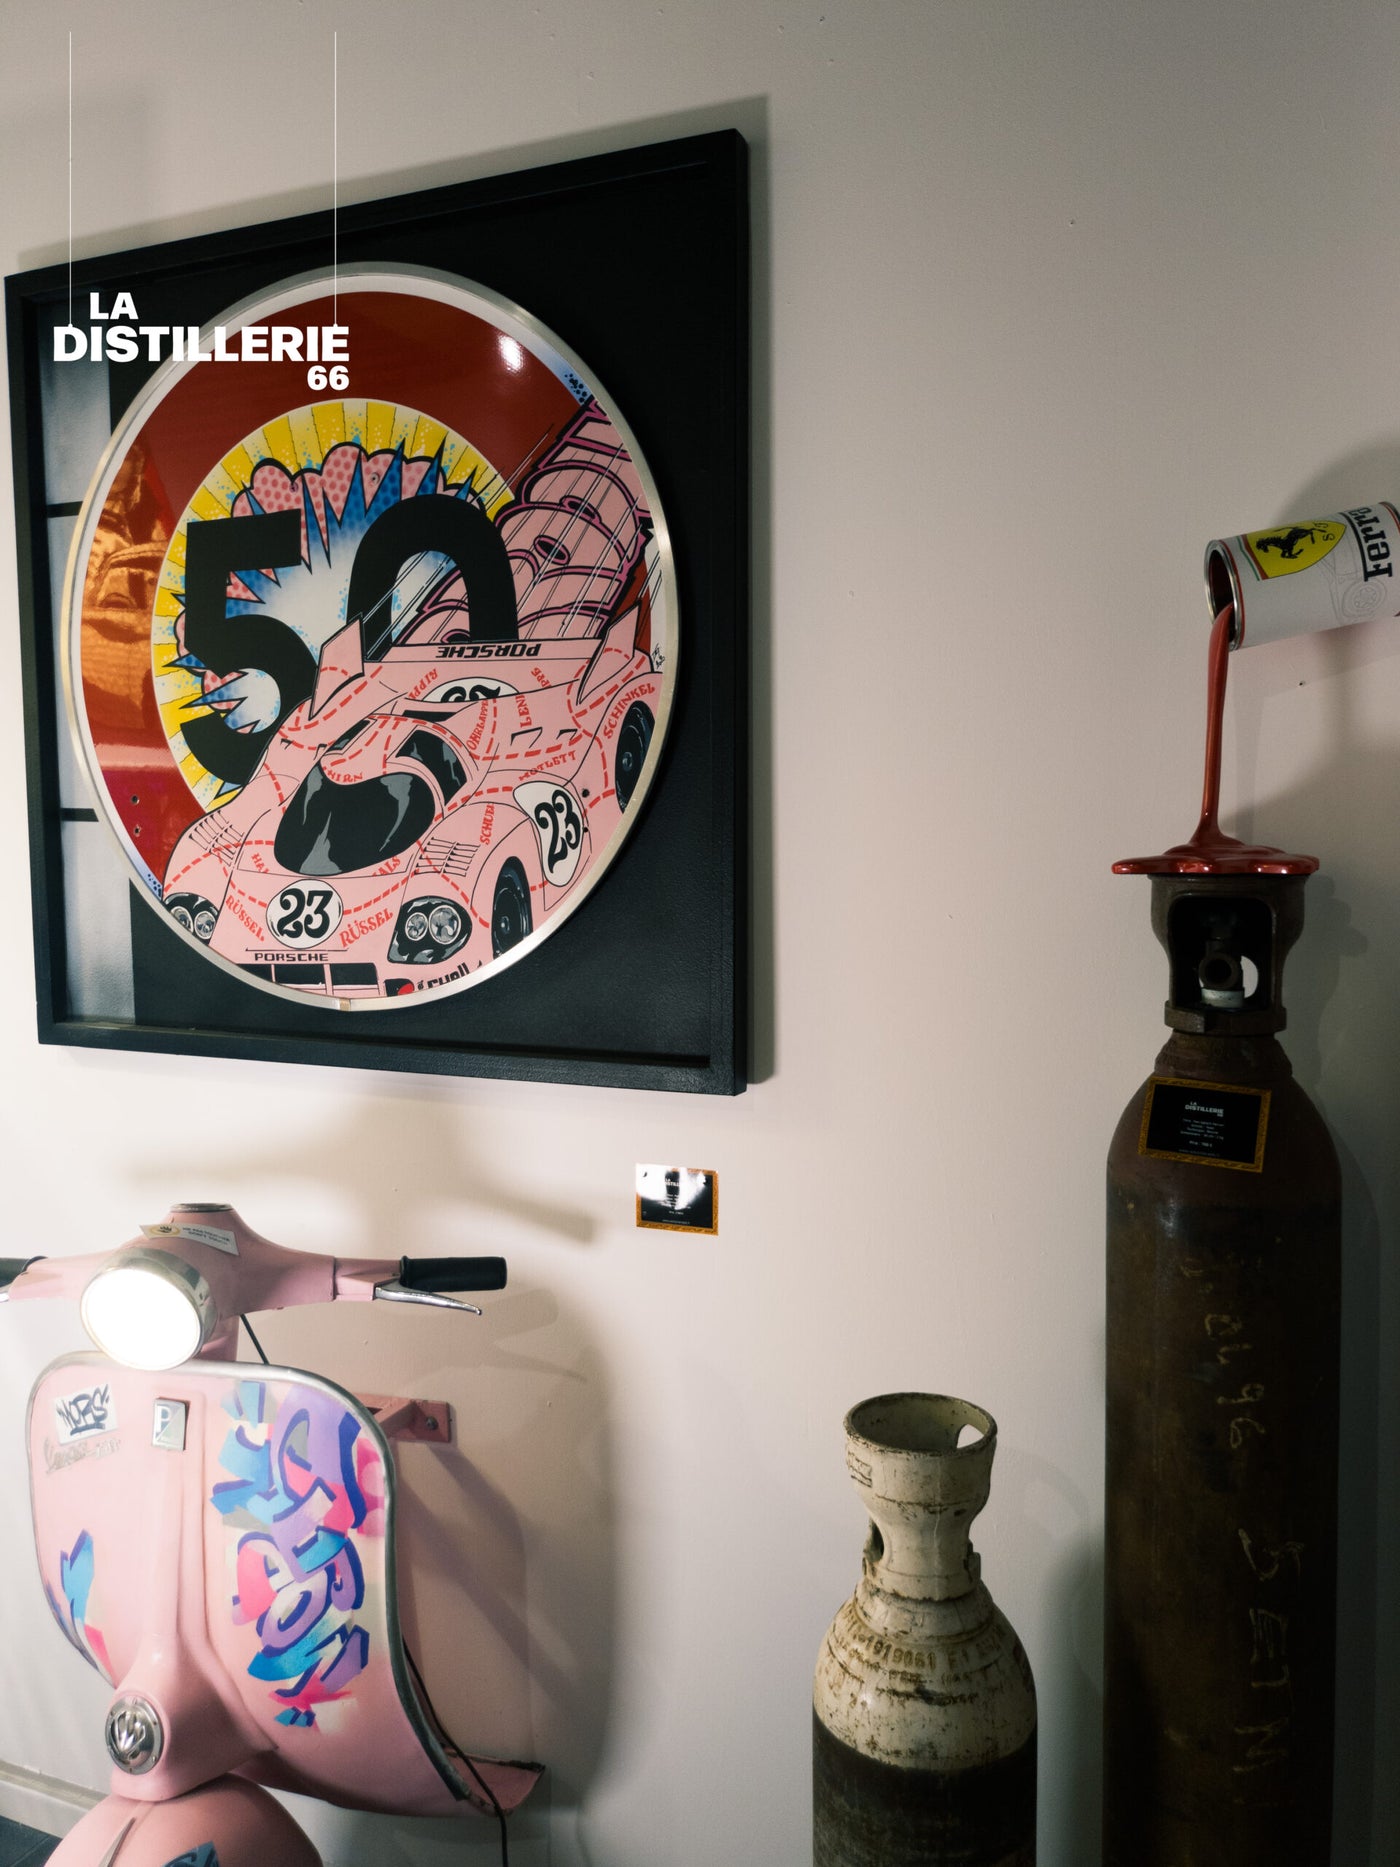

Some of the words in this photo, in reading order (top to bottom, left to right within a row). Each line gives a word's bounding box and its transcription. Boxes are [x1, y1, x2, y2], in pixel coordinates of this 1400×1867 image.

[435, 643, 542, 659] PORSCHE
[603, 682, 656, 739] SCHINKEL
[534, 789, 581, 873] 23
[371, 855, 401, 877] ALS
[277, 887, 333, 939] 23
[339, 908, 394, 948] RÜSSEL
[254, 952, 329, 962] PORSCHE
